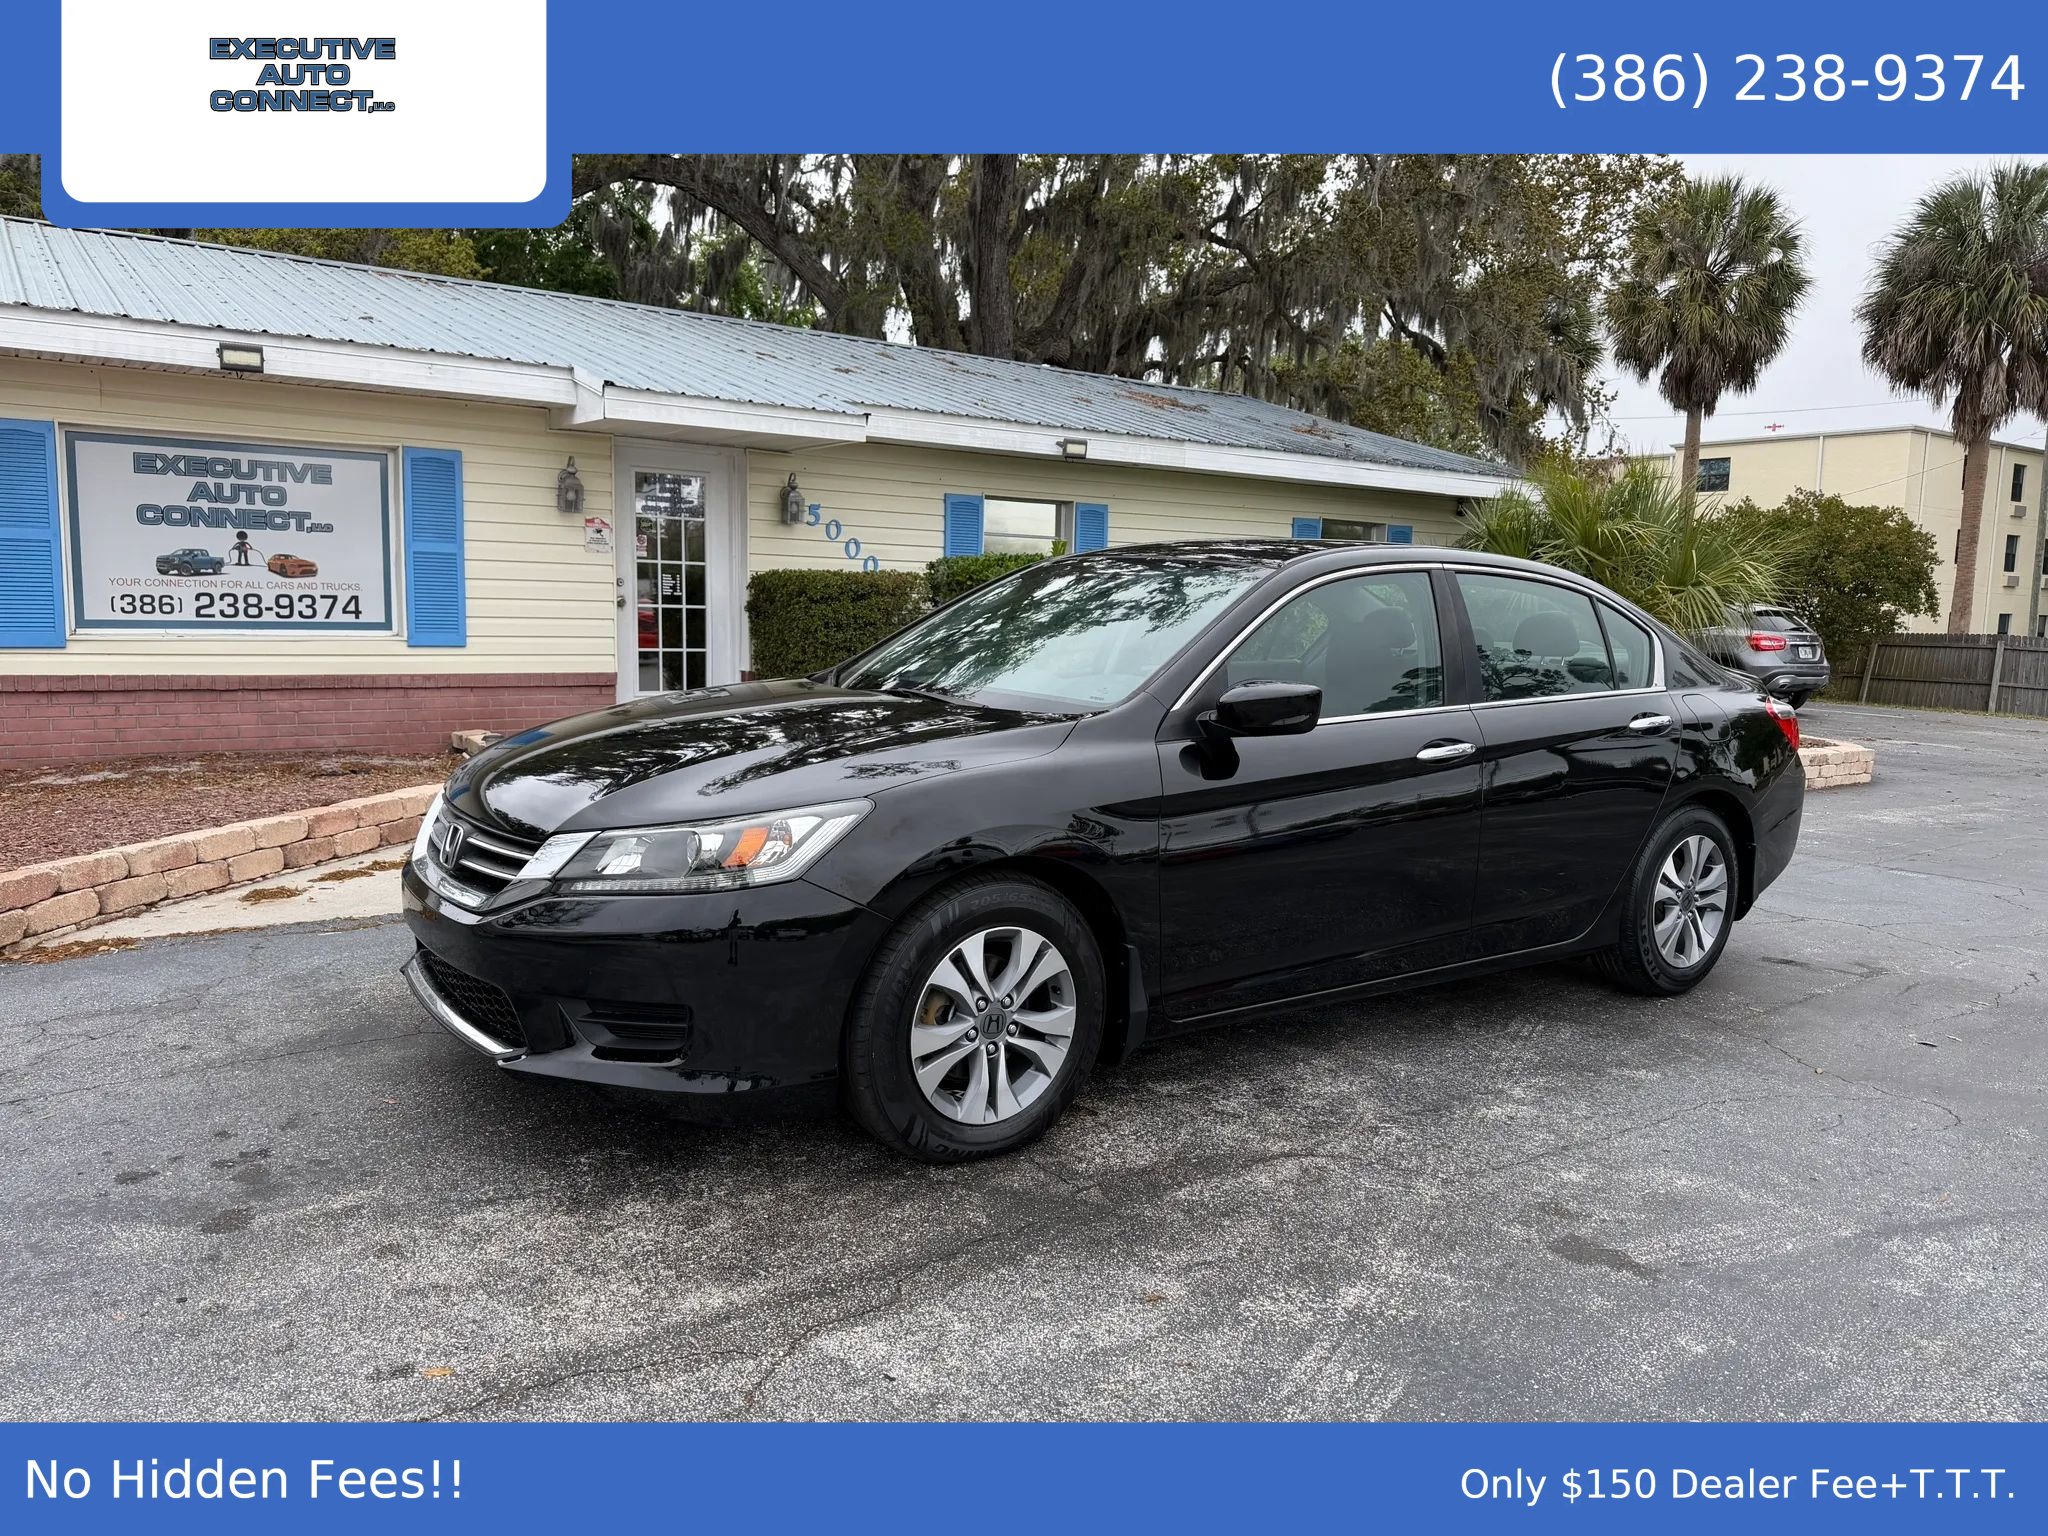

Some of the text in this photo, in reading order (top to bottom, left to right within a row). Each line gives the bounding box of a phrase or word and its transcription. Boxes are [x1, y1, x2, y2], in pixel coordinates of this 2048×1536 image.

[133, 452, 333, 485] EXECUTIVE
[187, 481, 287, 506] AUTO
[109, 577, 363, 591] YOUR CONNECTION FOR ALL CARS AND TRUCKS.
[111, 592, 362, 619] (386) 238-9374
